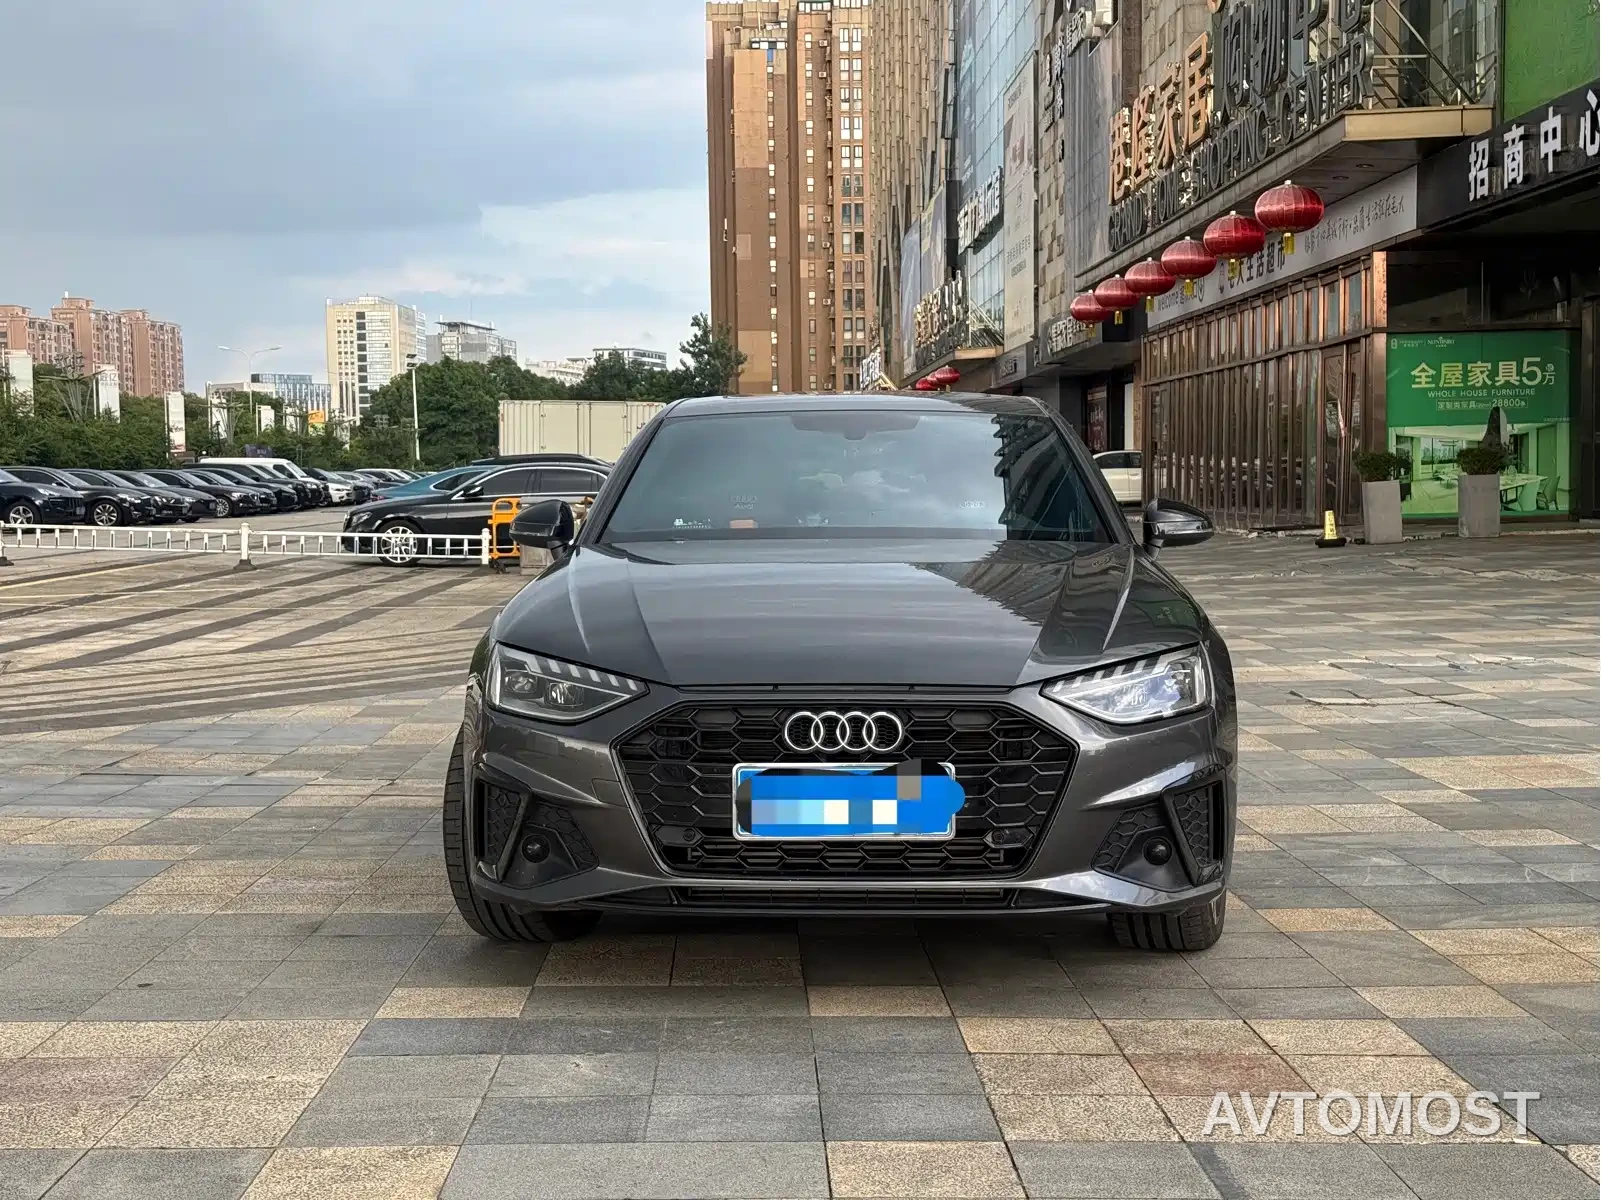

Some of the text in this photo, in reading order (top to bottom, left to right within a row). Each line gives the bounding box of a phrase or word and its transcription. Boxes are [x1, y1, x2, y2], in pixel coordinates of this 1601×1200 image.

[1108, 33, 1373, 252] GRAND HOME SHOPPING CENTER
[1468, 88, 1600, 202] 招商中心
[1427, 387, 1536, 398] WHOLE HOUSE FURNITURE
